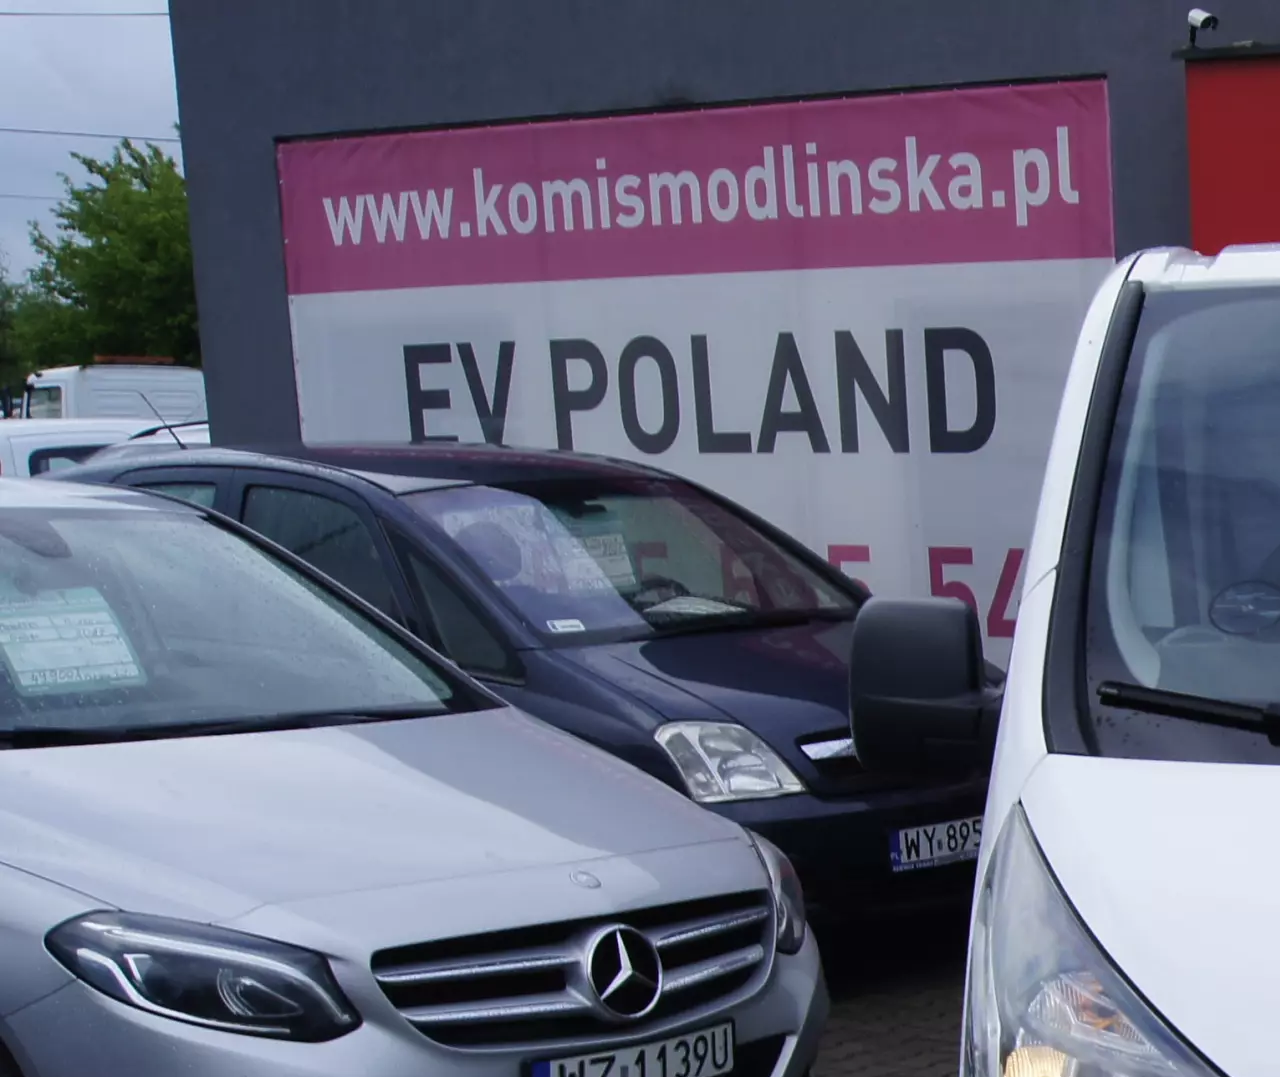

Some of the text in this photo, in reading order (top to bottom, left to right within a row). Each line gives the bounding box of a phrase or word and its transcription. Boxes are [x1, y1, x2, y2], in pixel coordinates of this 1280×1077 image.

[323, 126, 1080, 246] www.komismodlinska.pl
[403, 327, 998, 454] EV POLAND
[904, 827, 936, 860] WY
